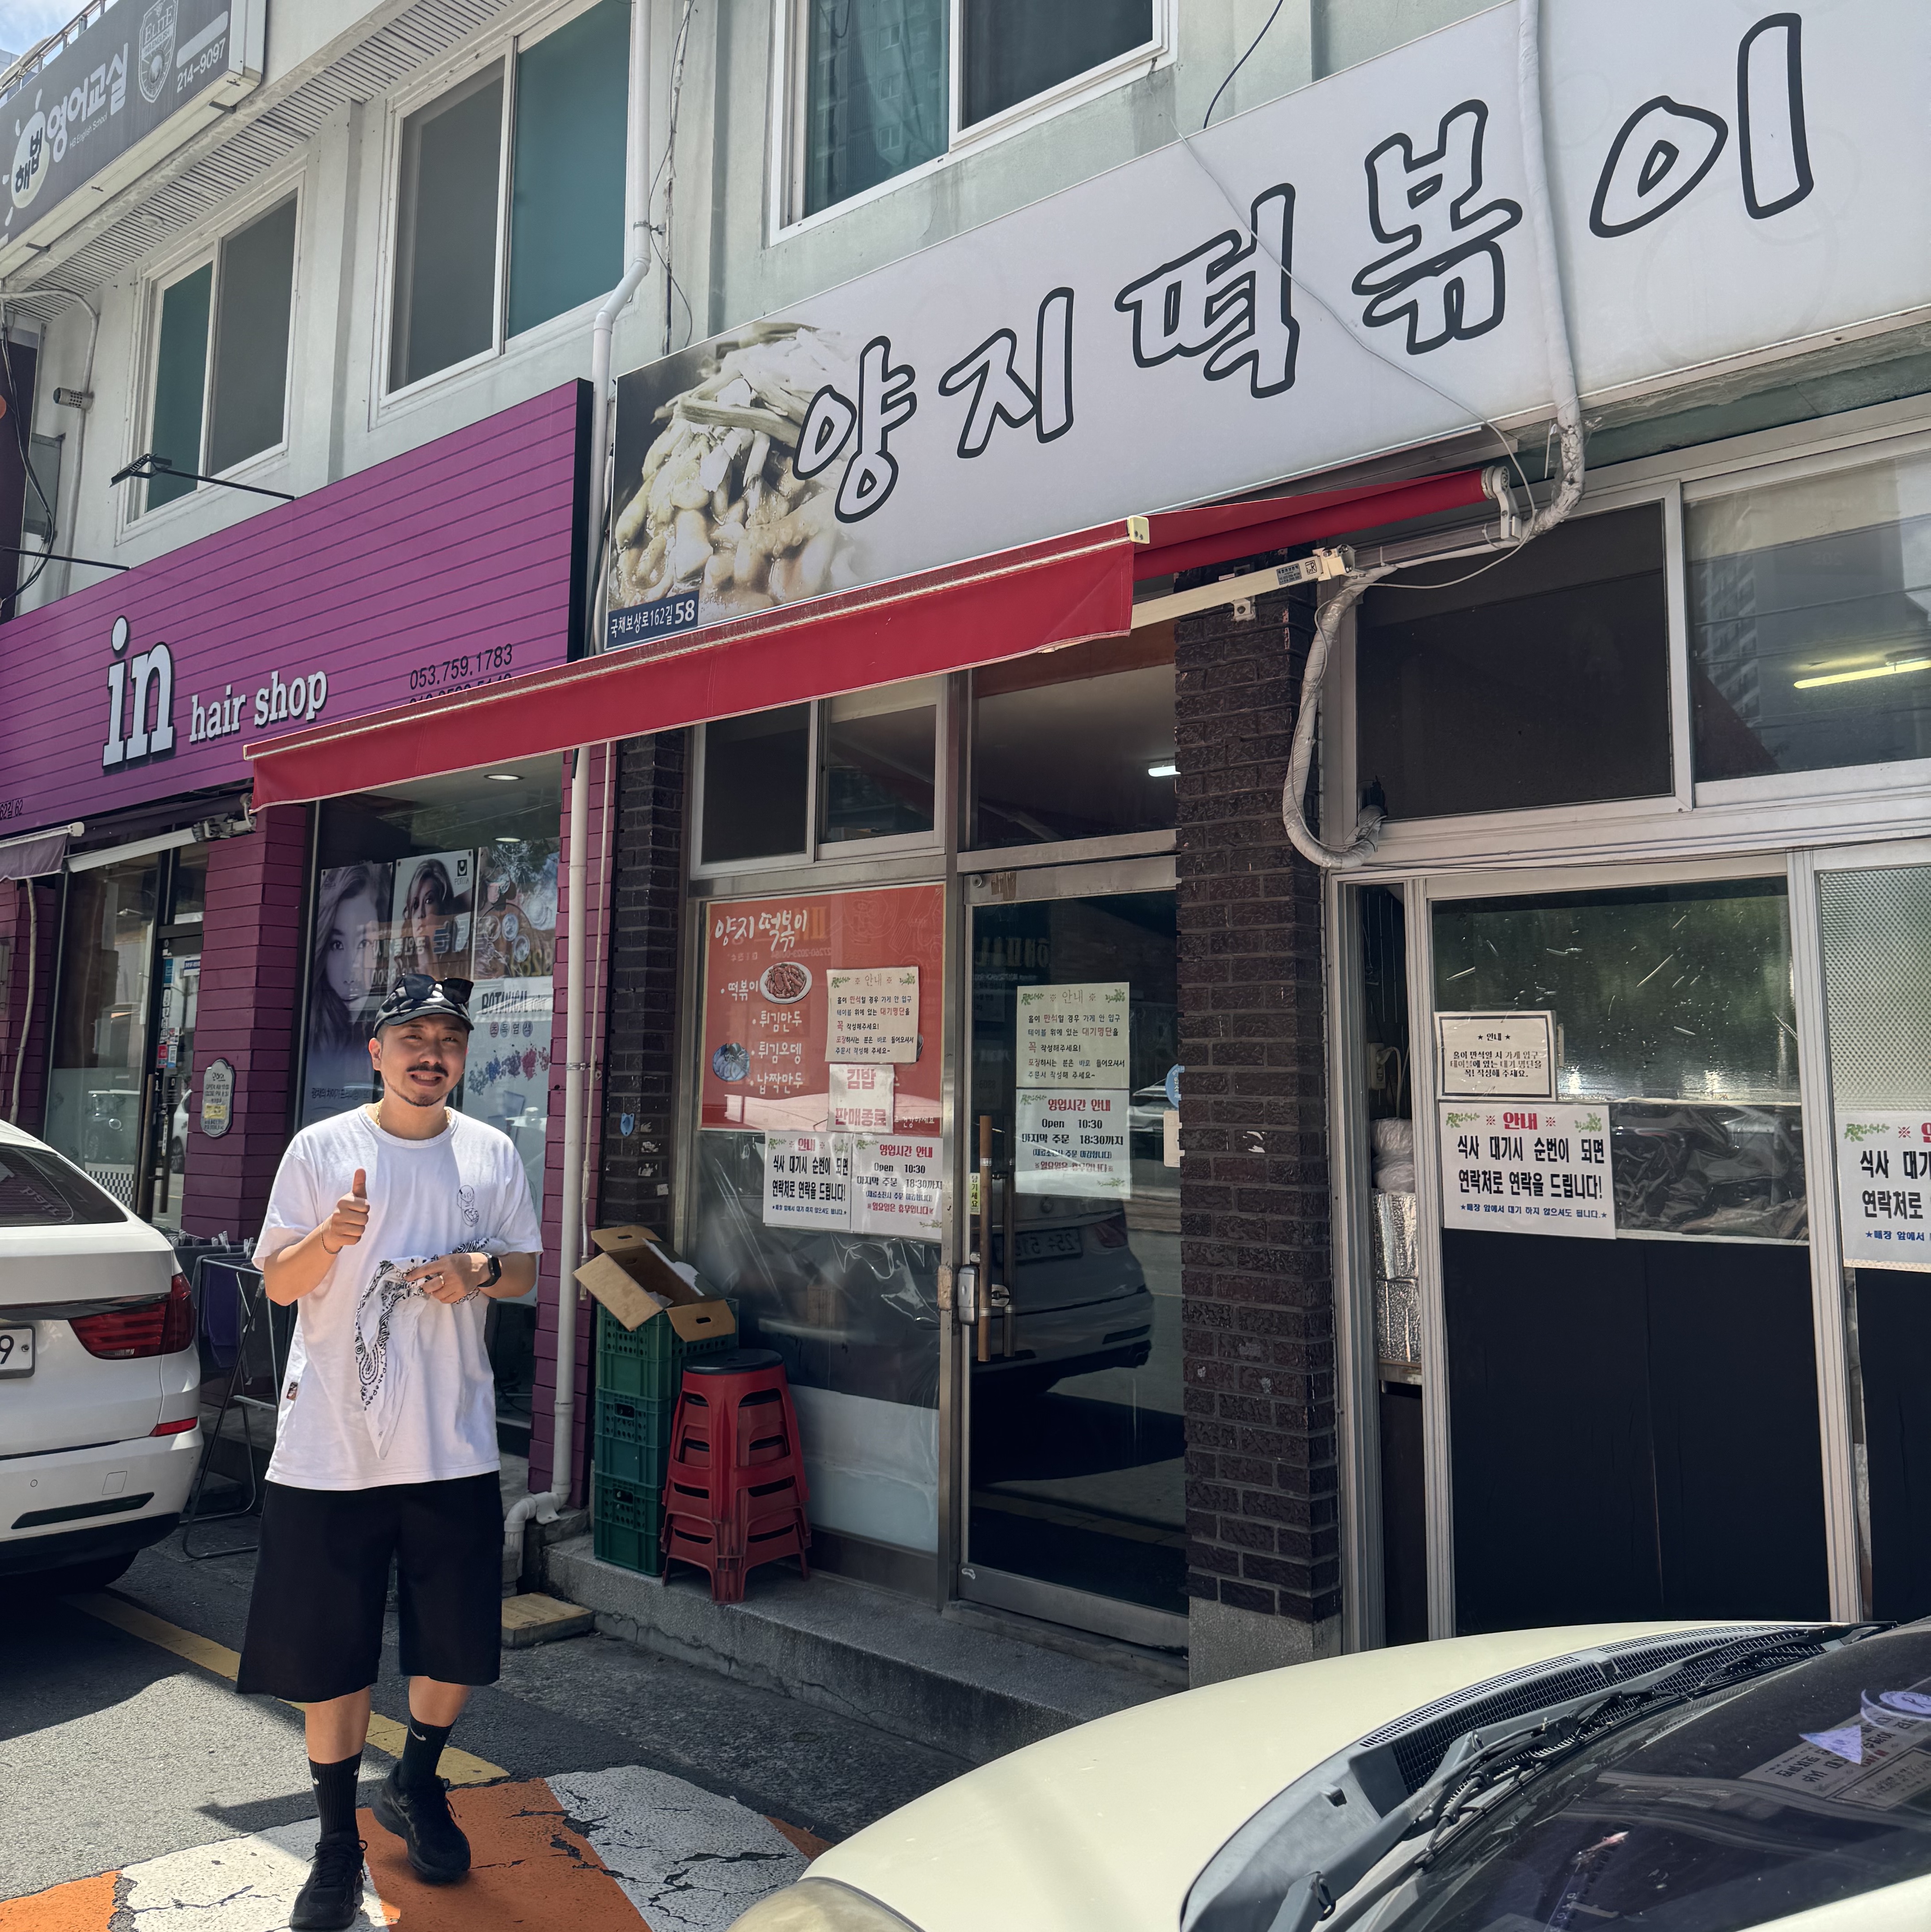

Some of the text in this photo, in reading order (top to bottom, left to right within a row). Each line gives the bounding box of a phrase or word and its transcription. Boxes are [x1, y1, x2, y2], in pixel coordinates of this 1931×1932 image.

[143, 5, 173, 45] ELITE
[177, 37, 226, 93] 214-9097
[15, 42, 128, 193] 해법 영어교실
[93, 111, 107, 130] School
[674, 599, 695, 624] 58
[410, 643, 513, 690] 053.759.1783
[102, 616, 328, 766] in hair shop
[715, 910, 807, 952] 양지 떡볶이
[865, 973, 882, 987] 안내
[728, 979, 758, 1001] 떡볶이
[1062, 989, 1082, 1004] 안내
[880, 1007, 910, 1016] 대기명단을
[1044, 1014, 1064, 1023] 만석일
[1068, 1015, 1079, 1023] 경우
[1108, 1014, 1120, 1023] 입구
[759, 1010, 803, 1033] 튀김만두
[837, 1020, 843, 1032] 꼭
[1082, 1028, 1118, 1037] 대기명단을
[1486, 1033, 1502, 1041] 안내
[758, 1041, 802, 1065] 튀김오뎅
[1028, 1042, 1037, 1053] 꼭
[1028, 1059, 1057, 1067] 포장하시는
[1470, 1051, 1492, 1060] 만석일
[1495, 1051, 1502, 1059] 시
[1505, 1051, 1520, 1059] 가게
[1450, 1060, 1480, 1068] 테이블에
[1483, 1060, 1498, 1068] 있는
[847, 1068, 876, 1090] 김밥
[1050, 1071, 1069, 1079] 작성해
[1477, 1069, 1500, 1077] 작성해
[757, 1072, 804, 1095] 납짝만두
[1048, 1099, 1111, 1111] 영업시간 안내
[835, 1108, 887, 1127] 판매종료
[1041, 1118, 1103, 1129] Open 10:30
[1502, 1111, 1538, 1130] 안내
[798, 1138, 816, 1152] 안내
[1022, 1133, 1124, 1146] 마지막 주문 18:30까지
[879, 1144, 933, 1159] 영업시간 안내
[1458, 1134, 1605, 1164] 식사 대기시 순번이 되면
[773, 1154, 849, 1176] 식사 대기시 순번이 되면
[873, 1162, 926, 1174] Open 10:30
[1860, 1150, 1890, 1179] 식사
[857, 1175, 943, 1190] 마지막 주문 18:30까지
[1458, 1169, 1603, 1200] 연락처로 연락을 드립니다!
[772, 1179, 846, 1202] 연락처로 연락을 드립니다!
[894, 1192, 904, 1200] 주문
[872, 1202, 929, 1215] 일요일은 휴무입니다
[1466, 1203, 1601, 1219] 매장 앞에서 대기 하지 않으셔도 됩니다.
[1862, 1189, 1924, 1220] 연락처로
[1874, 1230, 1925, 1242] 매장 앞에서
[0, 1335, 14, 1365] 9
